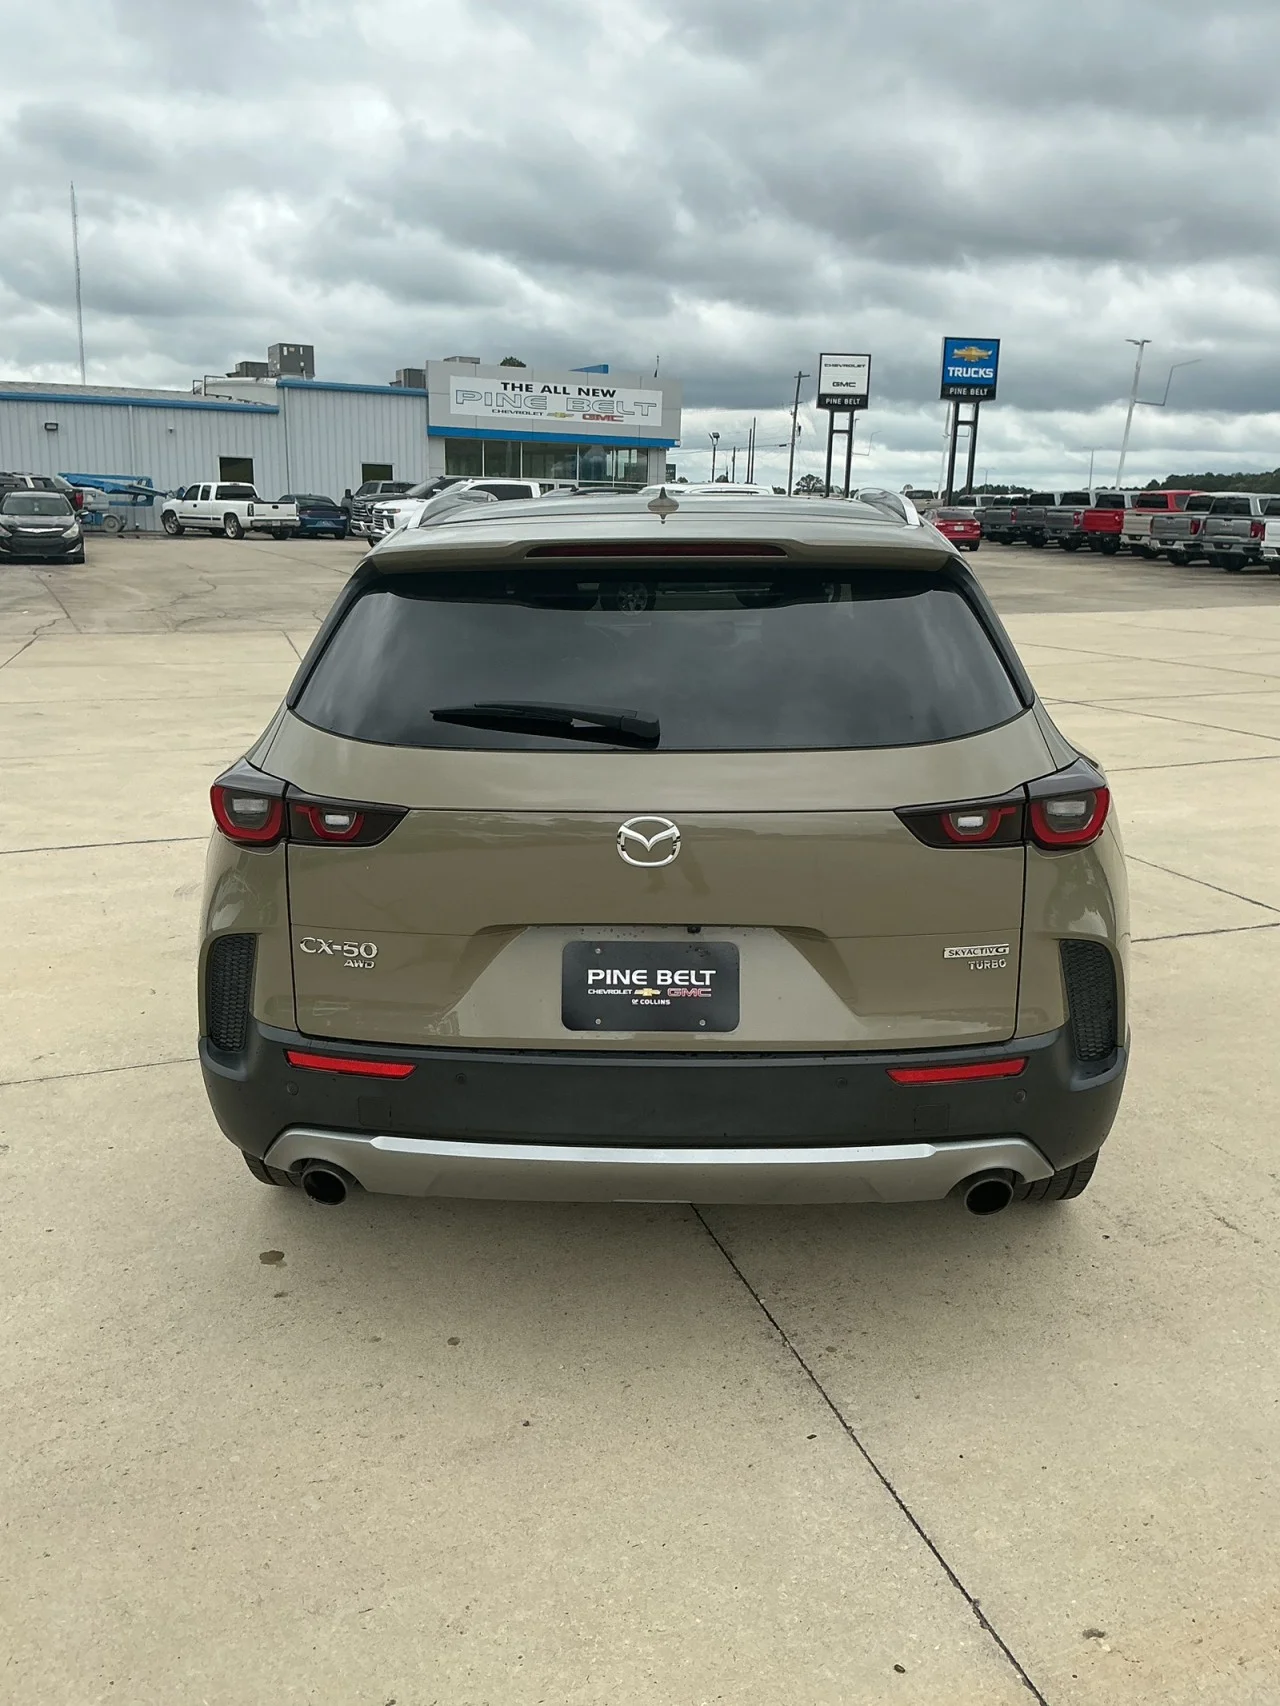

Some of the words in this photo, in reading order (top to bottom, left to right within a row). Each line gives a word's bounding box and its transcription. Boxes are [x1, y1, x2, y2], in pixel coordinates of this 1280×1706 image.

[947, 366, 994, 378] TRUCKS
[501, 382, 533, 393] THE
[540, 385, 571, 395] ALL
[577, 387, 616, 398] NEW
[949, 387, 967, 395] PINE
[970, 388, 989, 396] BELT
[455, 389, 547, 410] PINE
[566, 397, 657, 416] BELT
[582, 413, 624, 422] GMC
[300, 937, 377, 958] CX-50
[343, 960, 375, 969] AWD
[968, 959, 1007, 970] TURBO
[587, 969, 648, 985] PINE
[656, 969, 717, 986] BELT
[667, 988, 712, 997] GMC
